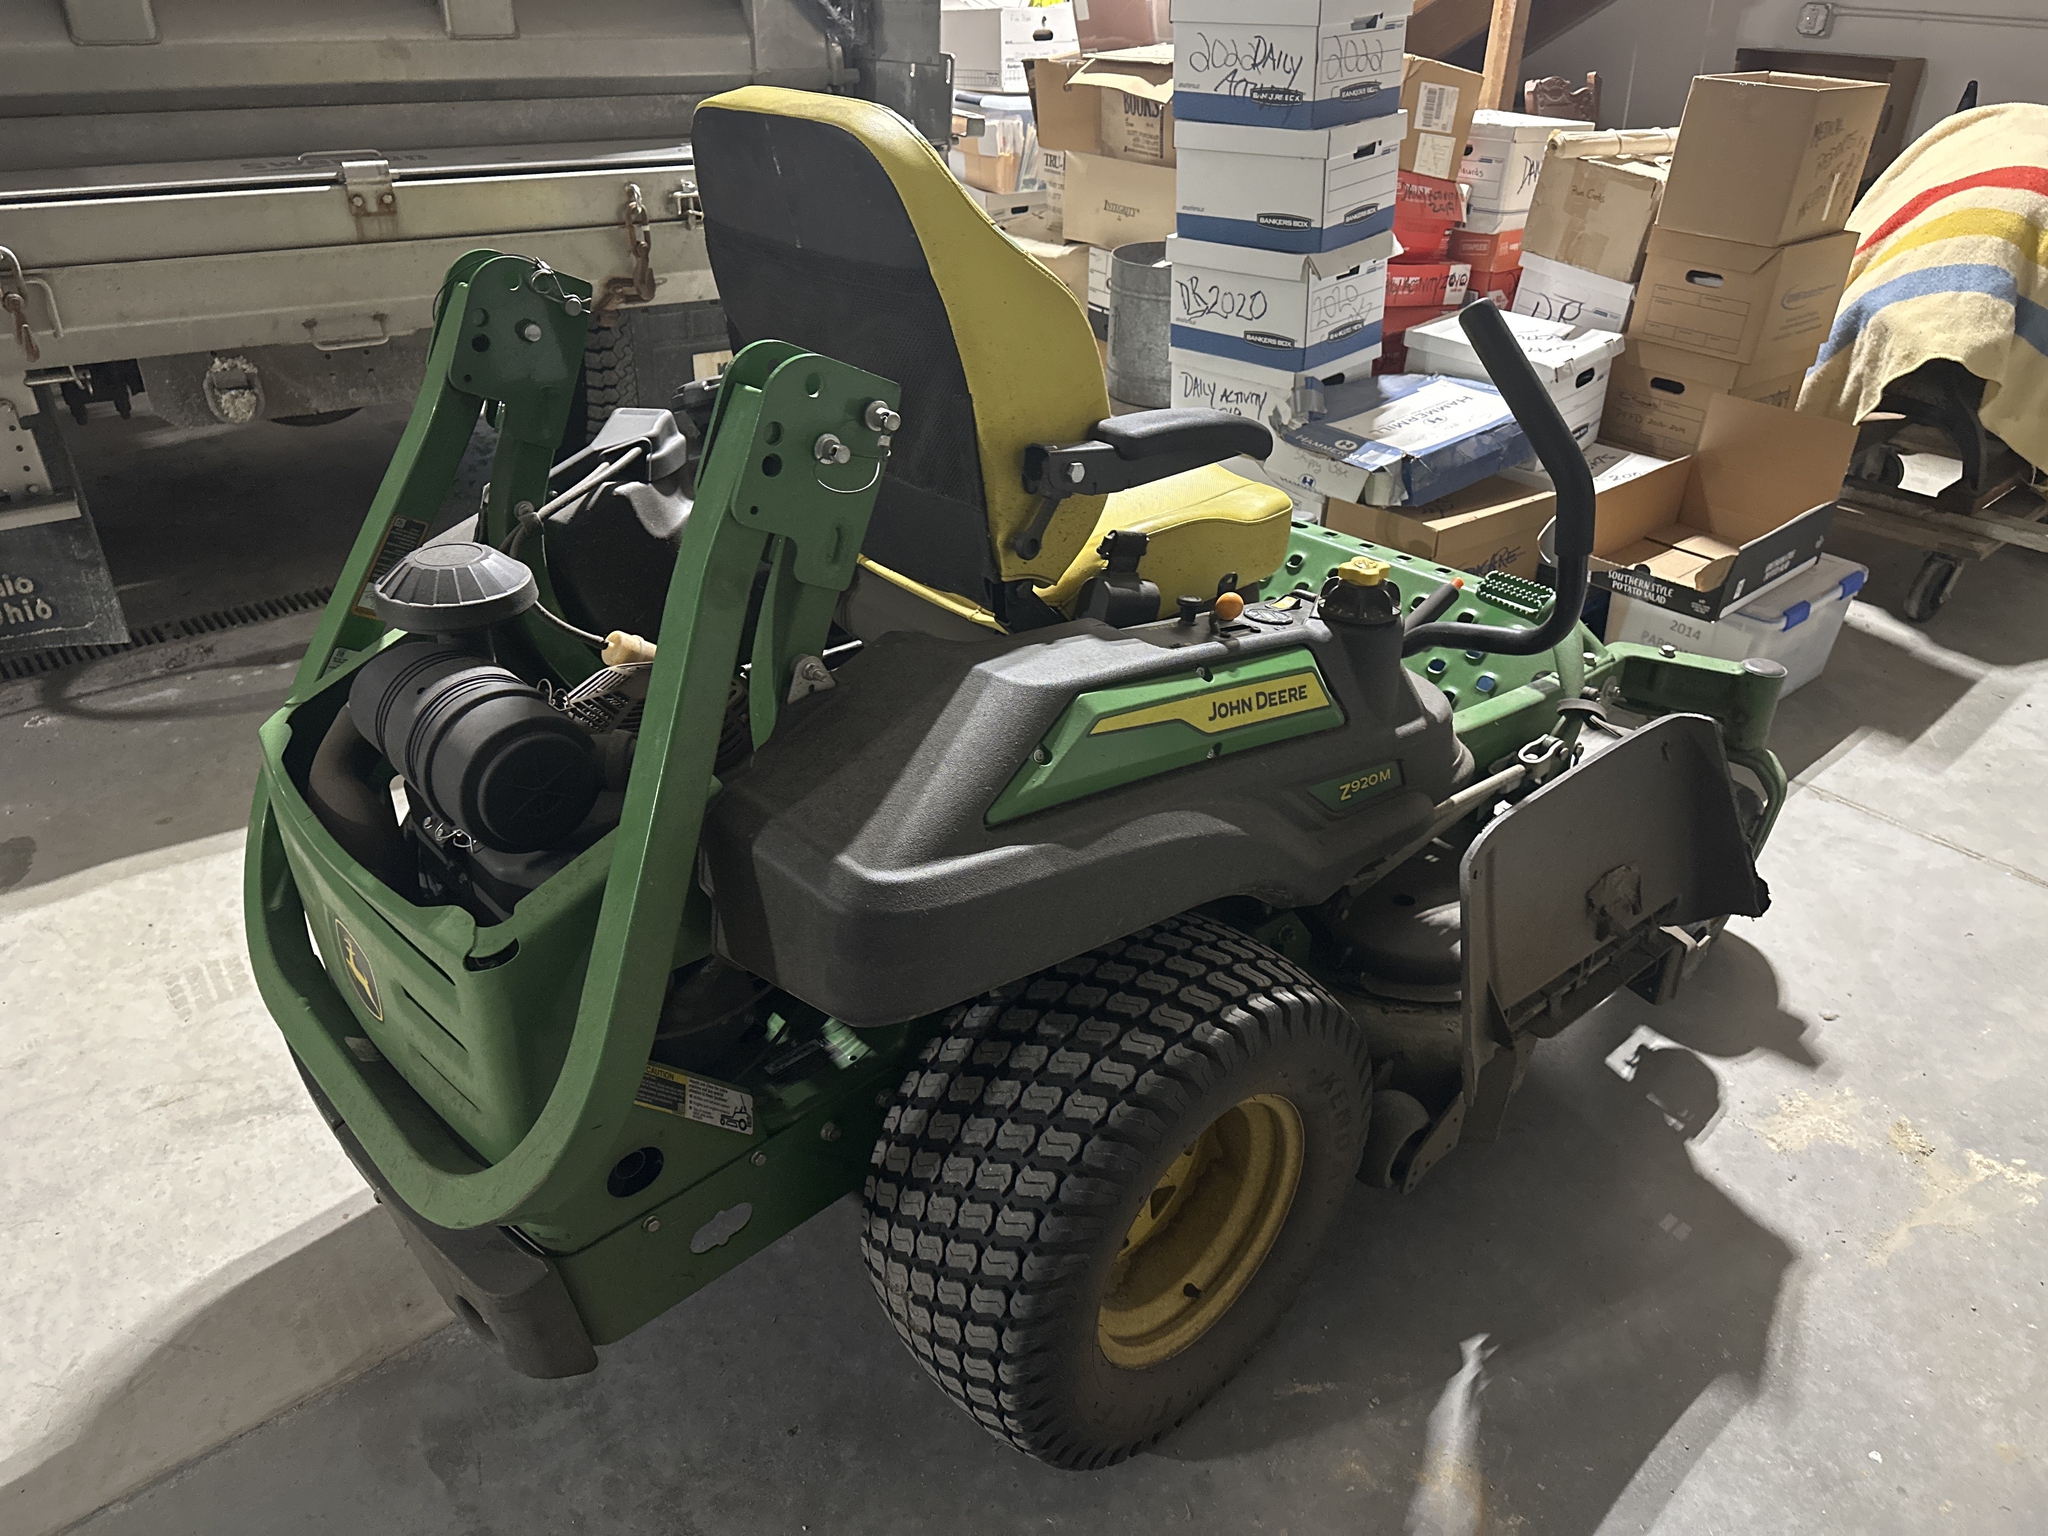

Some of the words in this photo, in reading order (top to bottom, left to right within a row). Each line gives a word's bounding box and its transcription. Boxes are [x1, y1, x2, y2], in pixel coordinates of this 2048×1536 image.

[1252, 35, 1303, 91] DAILY
[1258, 217, 1292, 228] BANKERS
[1293, 220, 1309, 229] BOX
[1345, 210, 1367, 224] BANKERS
[1366, 207, 1378, 217] BOX
[1246, 334, 1277, 346] BANKERS
[1277, 339, 1293, 349] BOX
[1181, 371, 1217, 408] DAILY
[1220, 387, 1268, 421] ACTIVITY
[1369, 395, 1474, 434] HAMMERMILL
[1608, 570, 1650, 591] SOUTHERN
[1651, 582, 1674, 599] STYLE
[1612, 580, 1643, 597] POTATO
[1644, 588, 1667, 605] SALAD
[1669, 620, 1703, 641] 2014
[1208, 697, 1253, 722] JOHN
[1255, 685, 1308, 710] DEERE
[1340, 768, 1391, 801] Z920M
[645, 1065, 675, 1081] CAUTION
